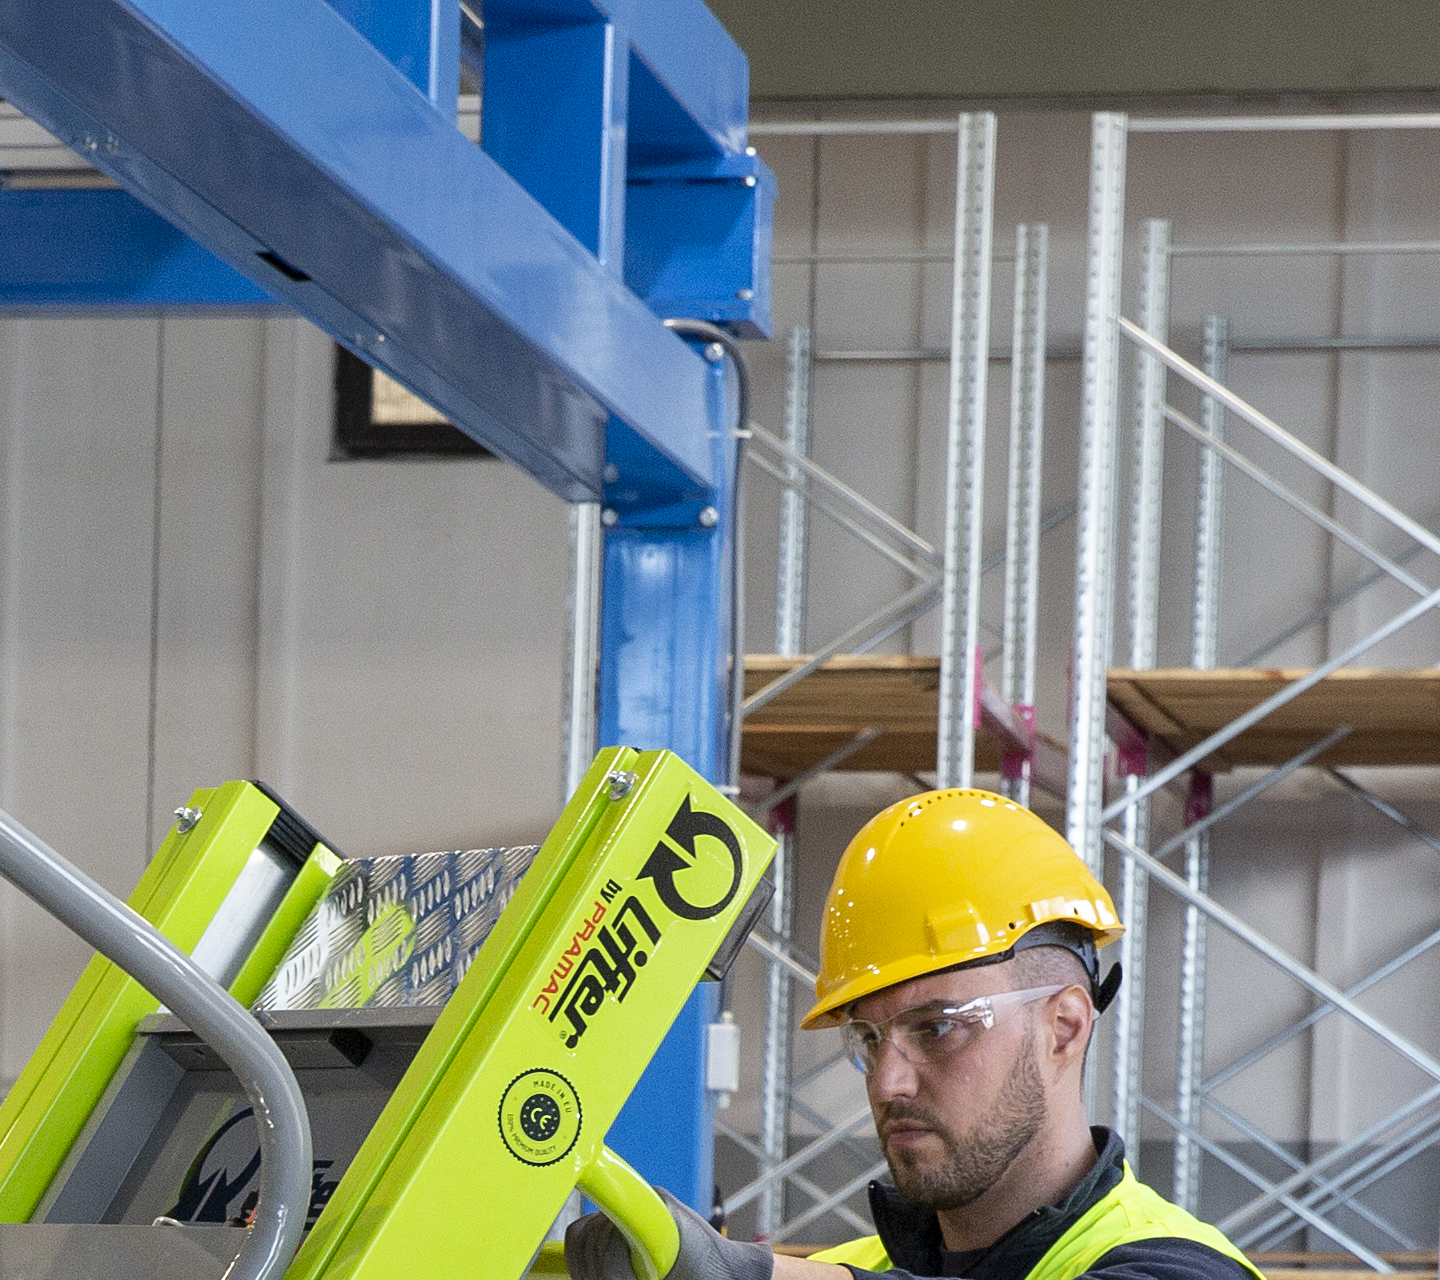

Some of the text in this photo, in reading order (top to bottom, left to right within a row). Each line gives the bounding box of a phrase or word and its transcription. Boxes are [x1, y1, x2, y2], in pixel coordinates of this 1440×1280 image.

[532, 878, 623, 1015] by PRAMAC
[533, 1080, 572, 1113] MADE IN EU
